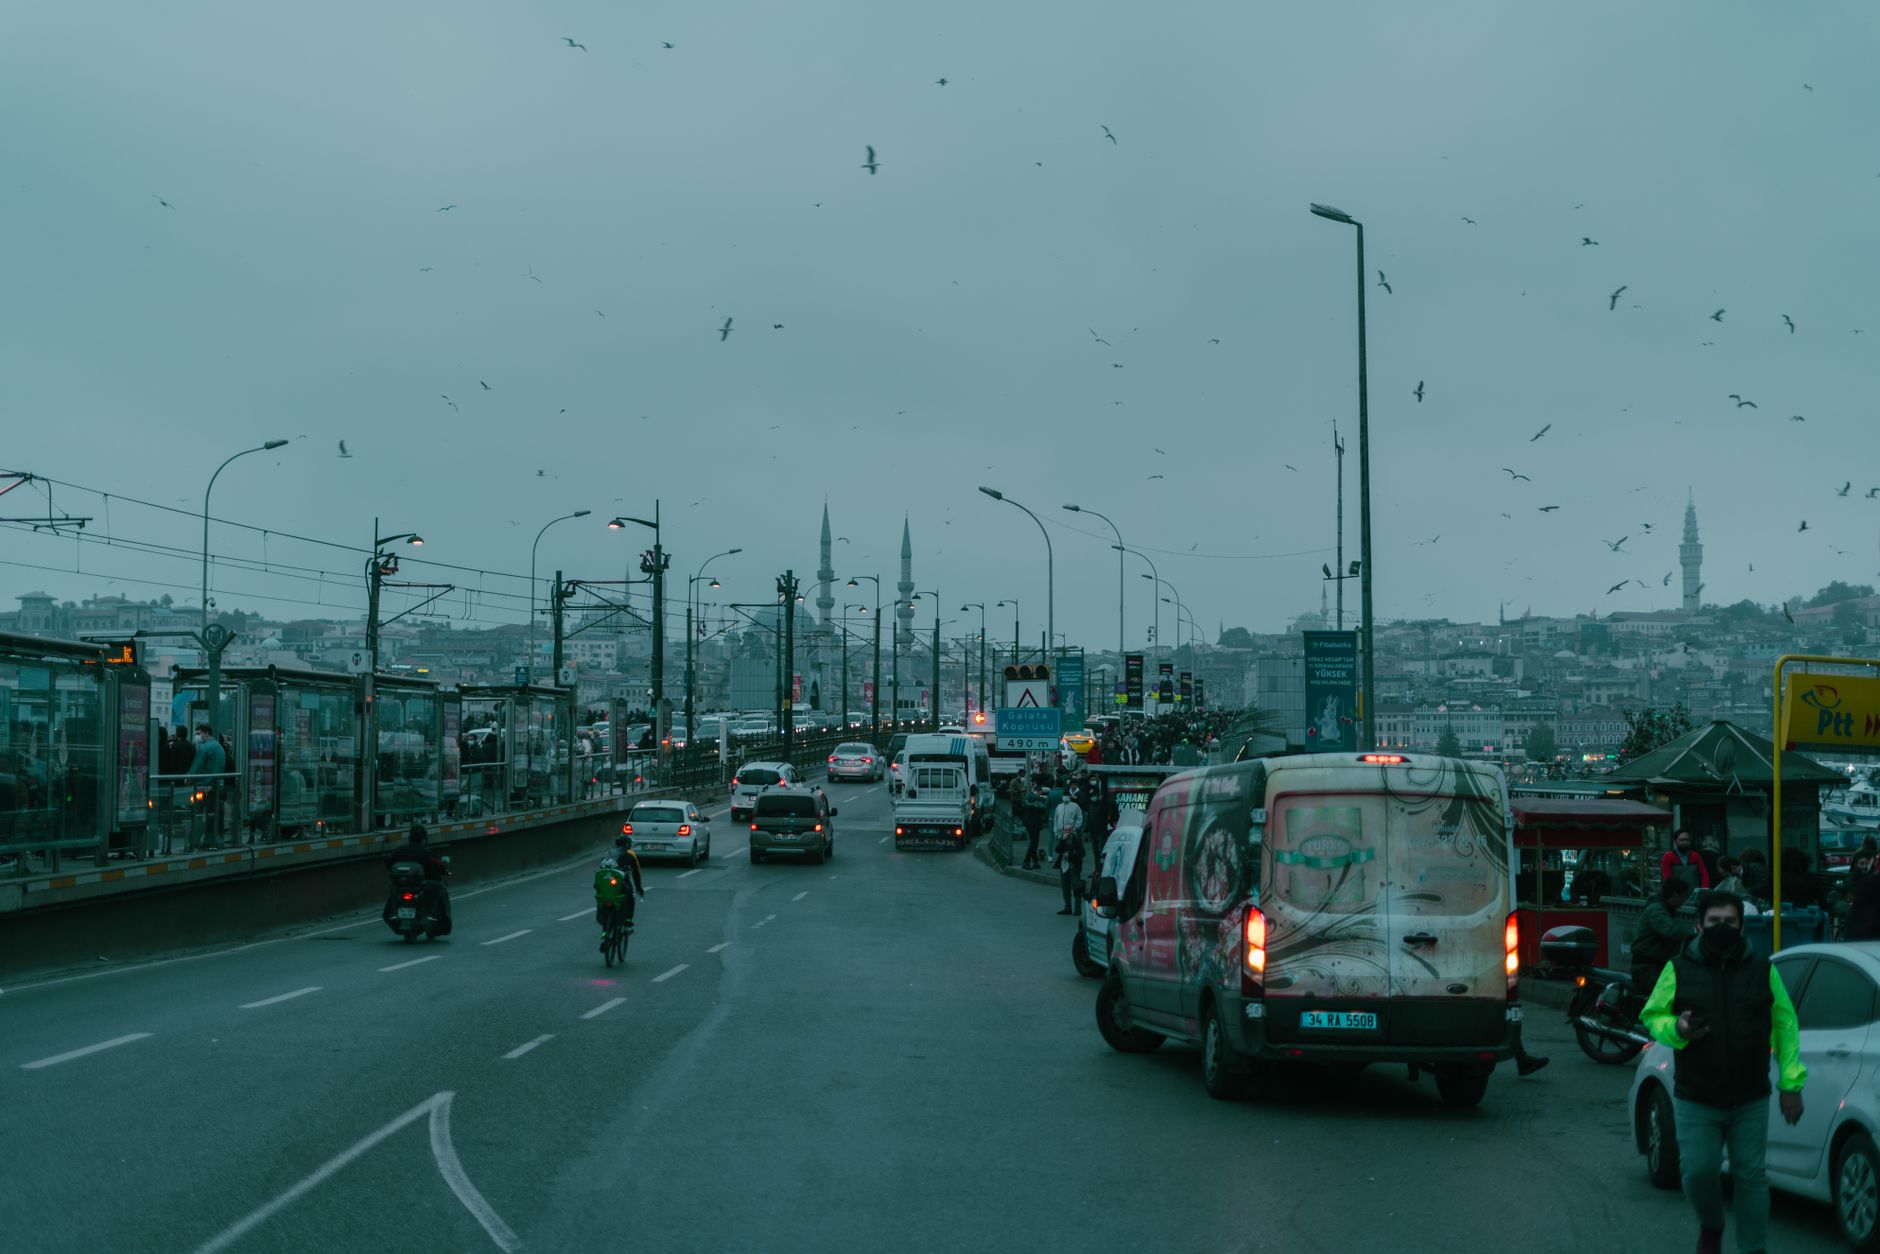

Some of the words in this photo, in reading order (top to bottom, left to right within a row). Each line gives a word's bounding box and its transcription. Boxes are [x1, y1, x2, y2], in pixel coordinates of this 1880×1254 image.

[1315, 668, 1348, 678] YÜKSEK
[1008, 711, 1048, 720] Galata
[1002, 721, 1054, 732] Köprüsü
[1816, 708, 1855, 737] Ptt
[1007, 739, 1033, 748] 490
[1308, 1013, 1322, 1026] 34
[1327, 1013, 1341, 1027] RA
[1346, 1014, 1374, 1028] 5508
